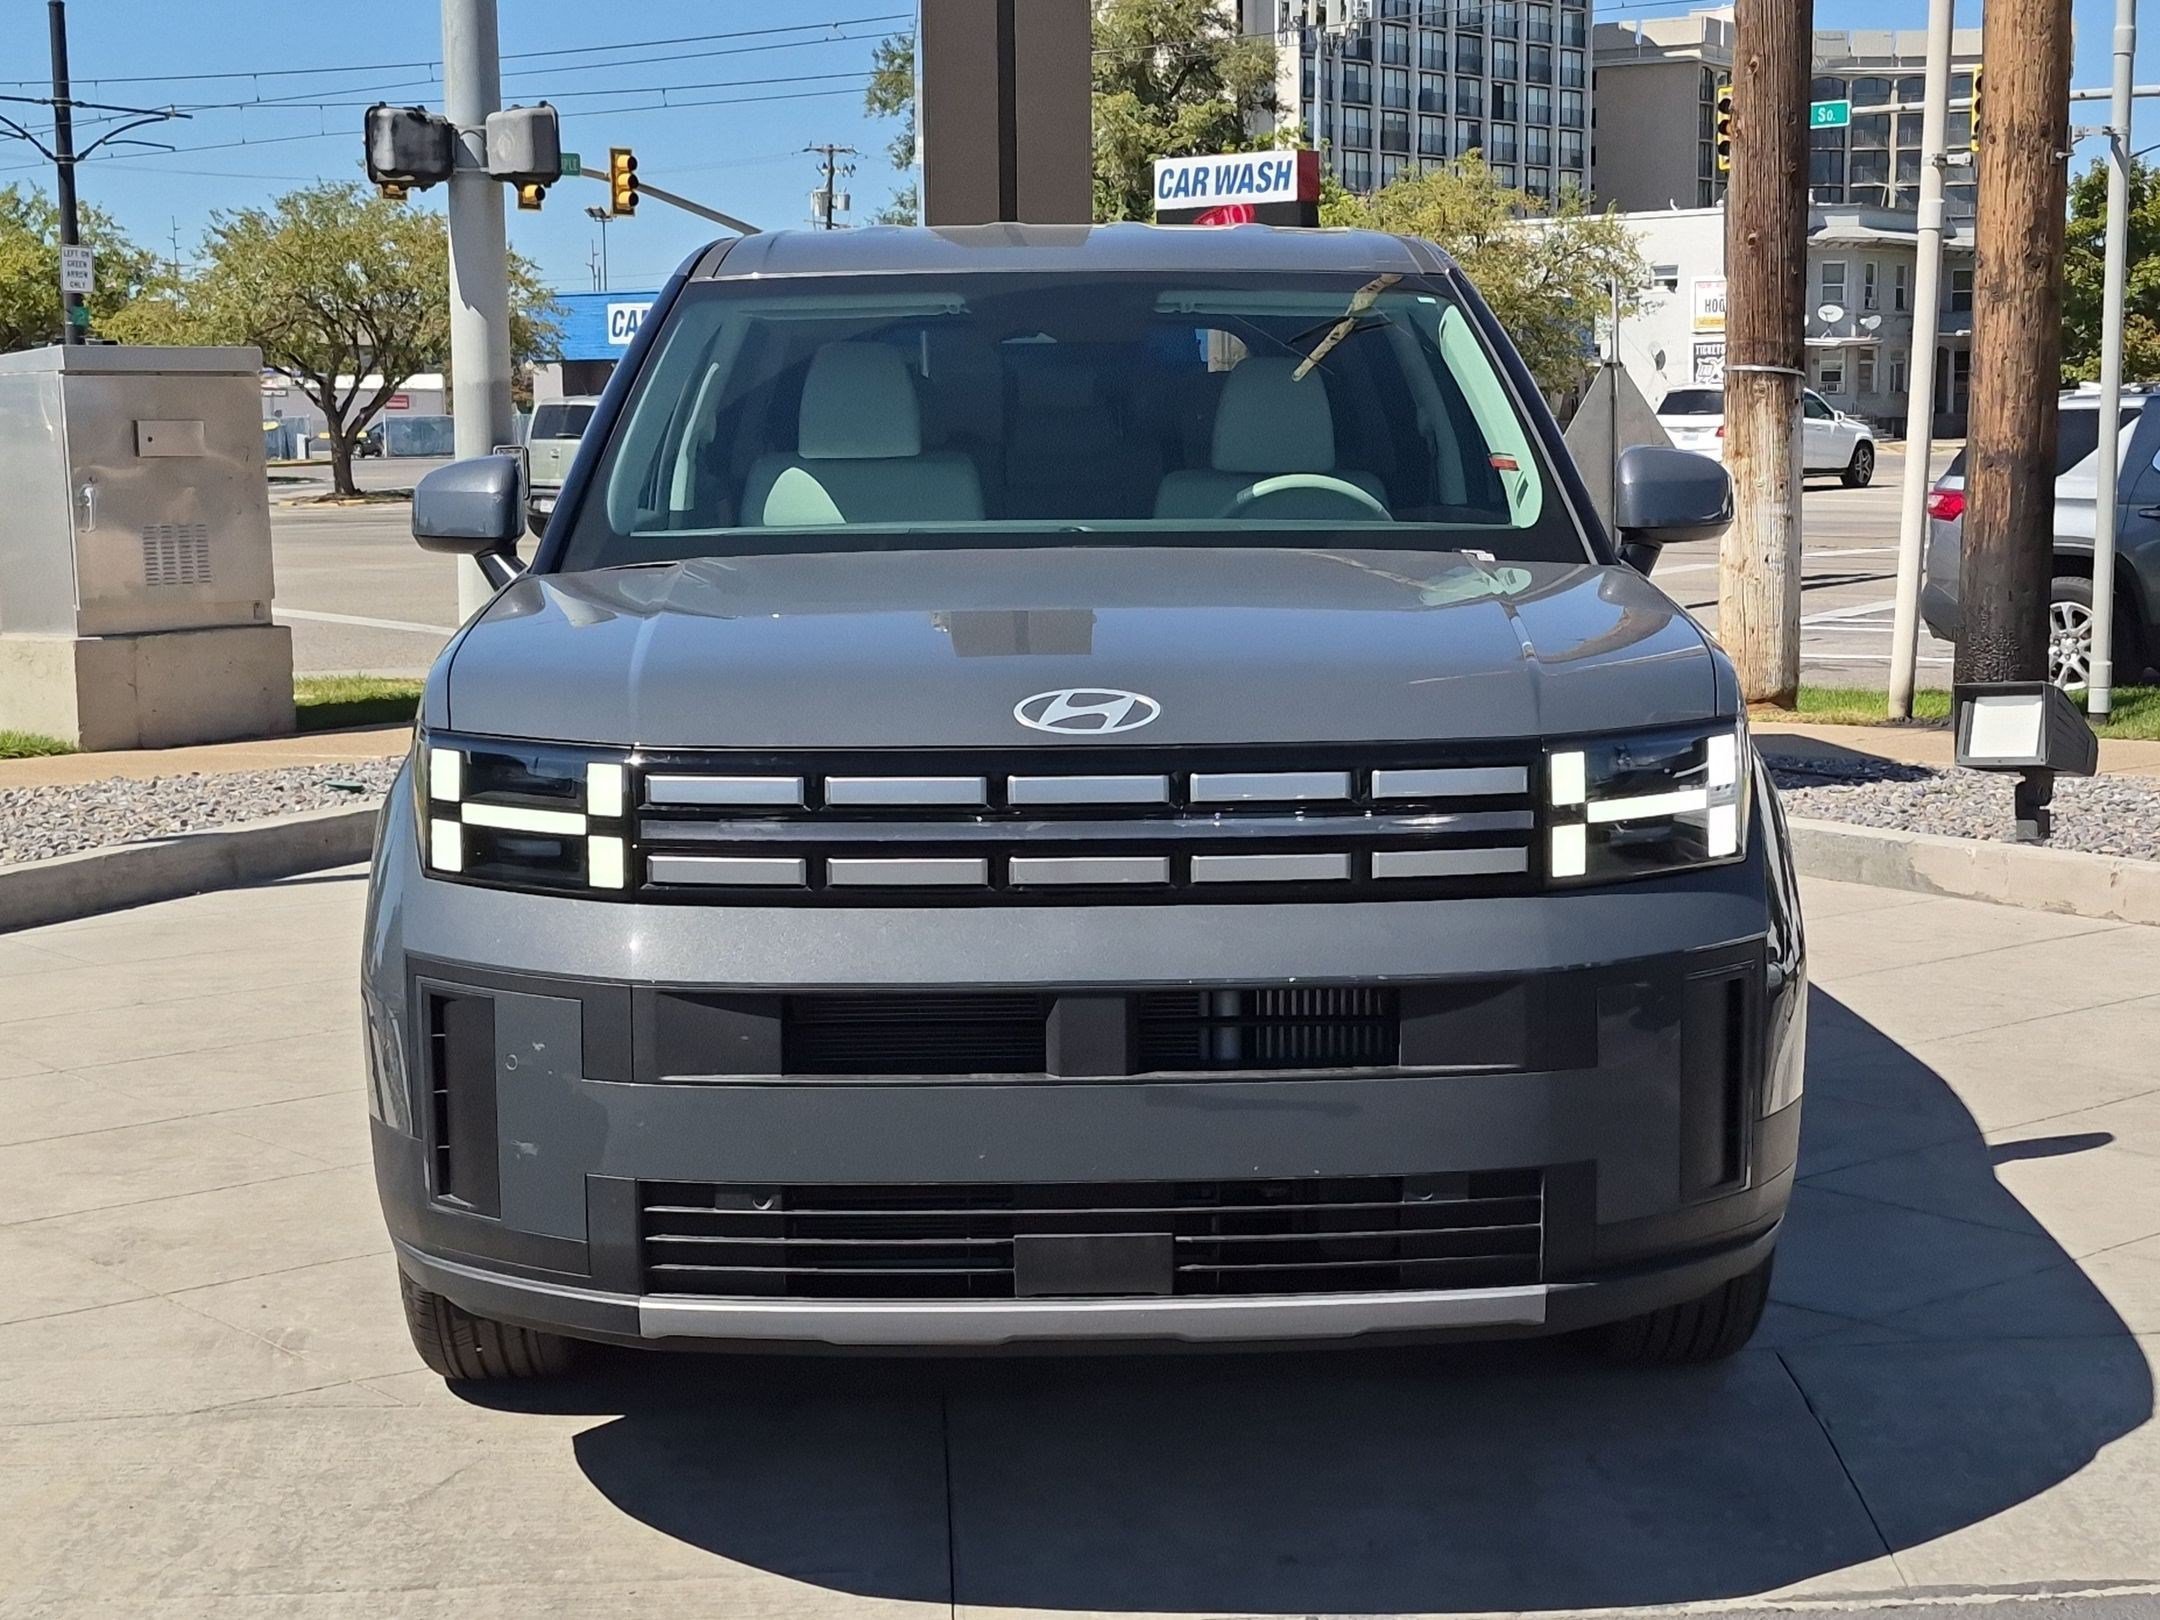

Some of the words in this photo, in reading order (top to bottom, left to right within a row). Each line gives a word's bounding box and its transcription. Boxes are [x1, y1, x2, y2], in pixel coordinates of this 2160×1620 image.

[1817, 106, 1836, 123] So.
[1158, 166, 1210, 200] CAR
[1214, 159, 1294, 196] WASH
[63, 249, 78, 258] LEFT
[80, 250, 90, 258] ON
[66, 260, 88, 268] GREEN
[66, 270, 89, 279] ARROW
[69, 281, 86, 289] ONLY
